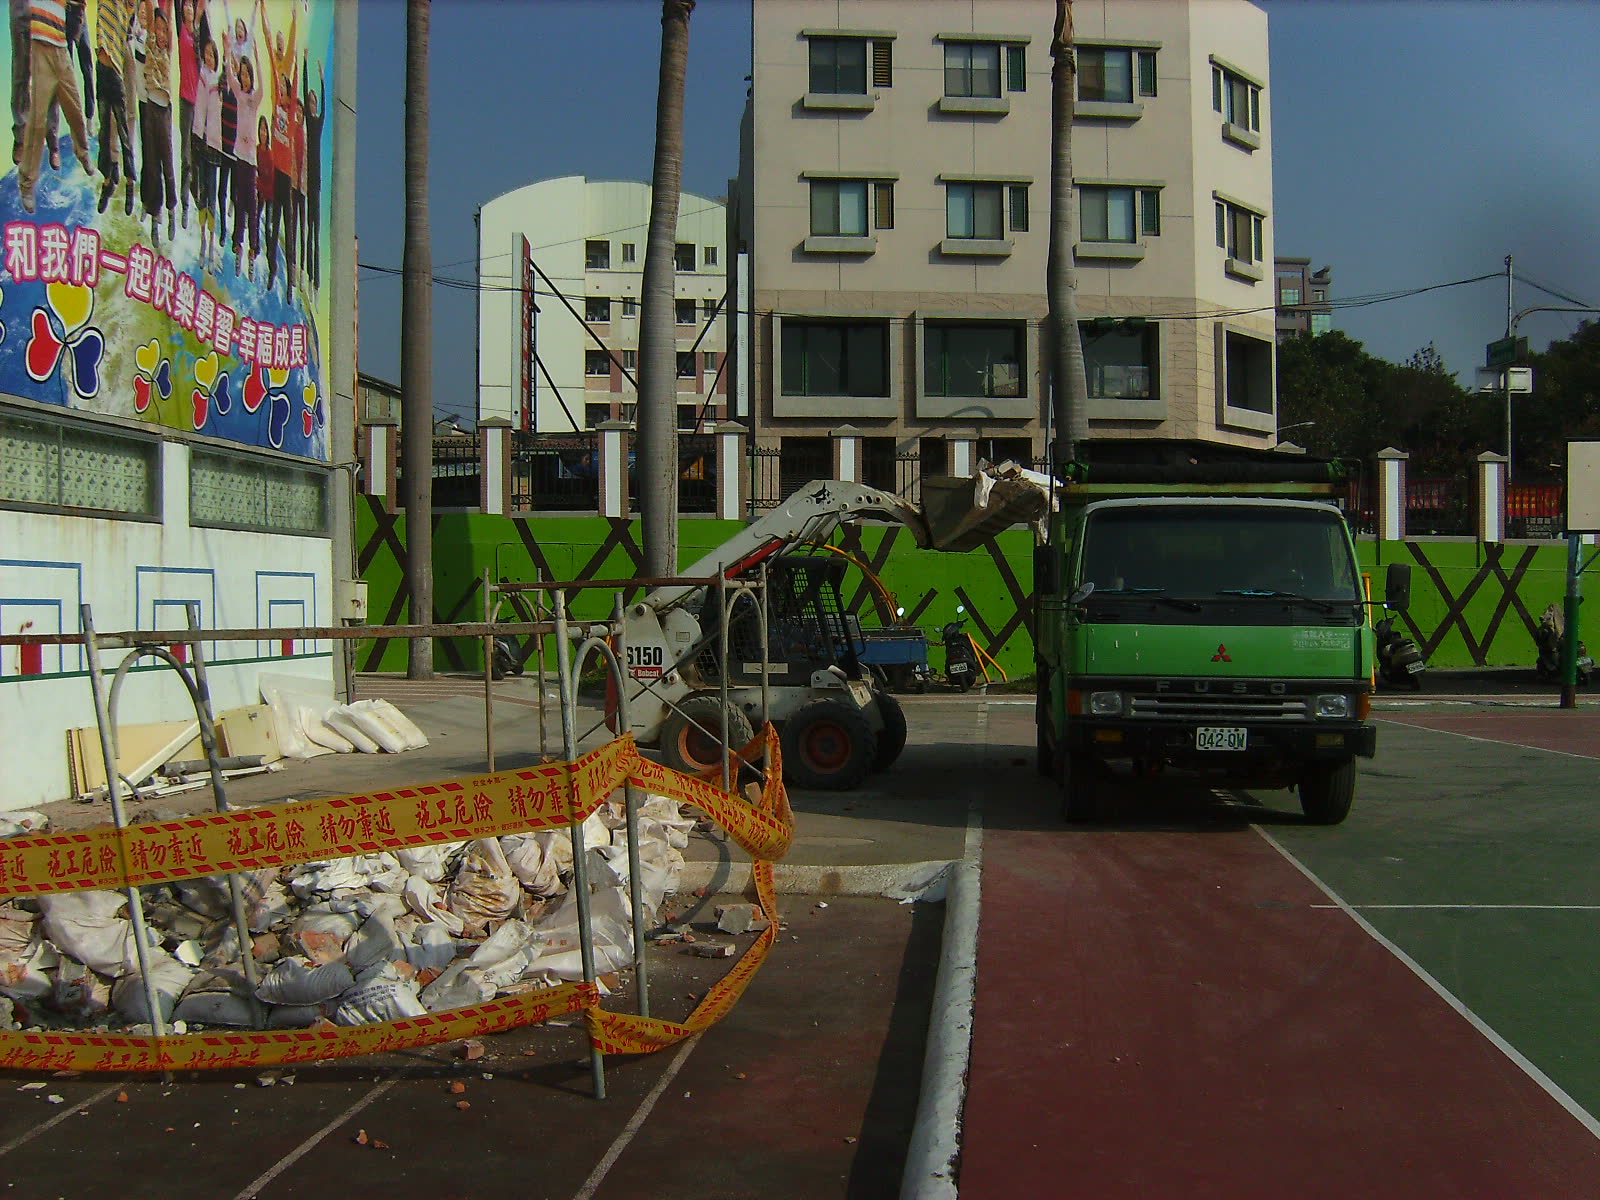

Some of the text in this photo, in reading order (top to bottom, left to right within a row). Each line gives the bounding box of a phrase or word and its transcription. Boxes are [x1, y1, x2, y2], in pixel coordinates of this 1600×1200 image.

[627, 647, 662, 665] S150
[637, 669, 660, 677] Bobcat
[1157, 681, 1286, 694] FUSO
[1198, 733, 1244, 747] 042-QW
[48, 844, 117, 878] 施工危險
[131, 832, 208, 870] 請勿靠近
[227, 818, 305, 856] 施工危險
[319, 805, 395, 845] 請勿靠近
[415, 791, 494, 829] 施工危險
[508, 777, 582, 817] 請勿靠近
